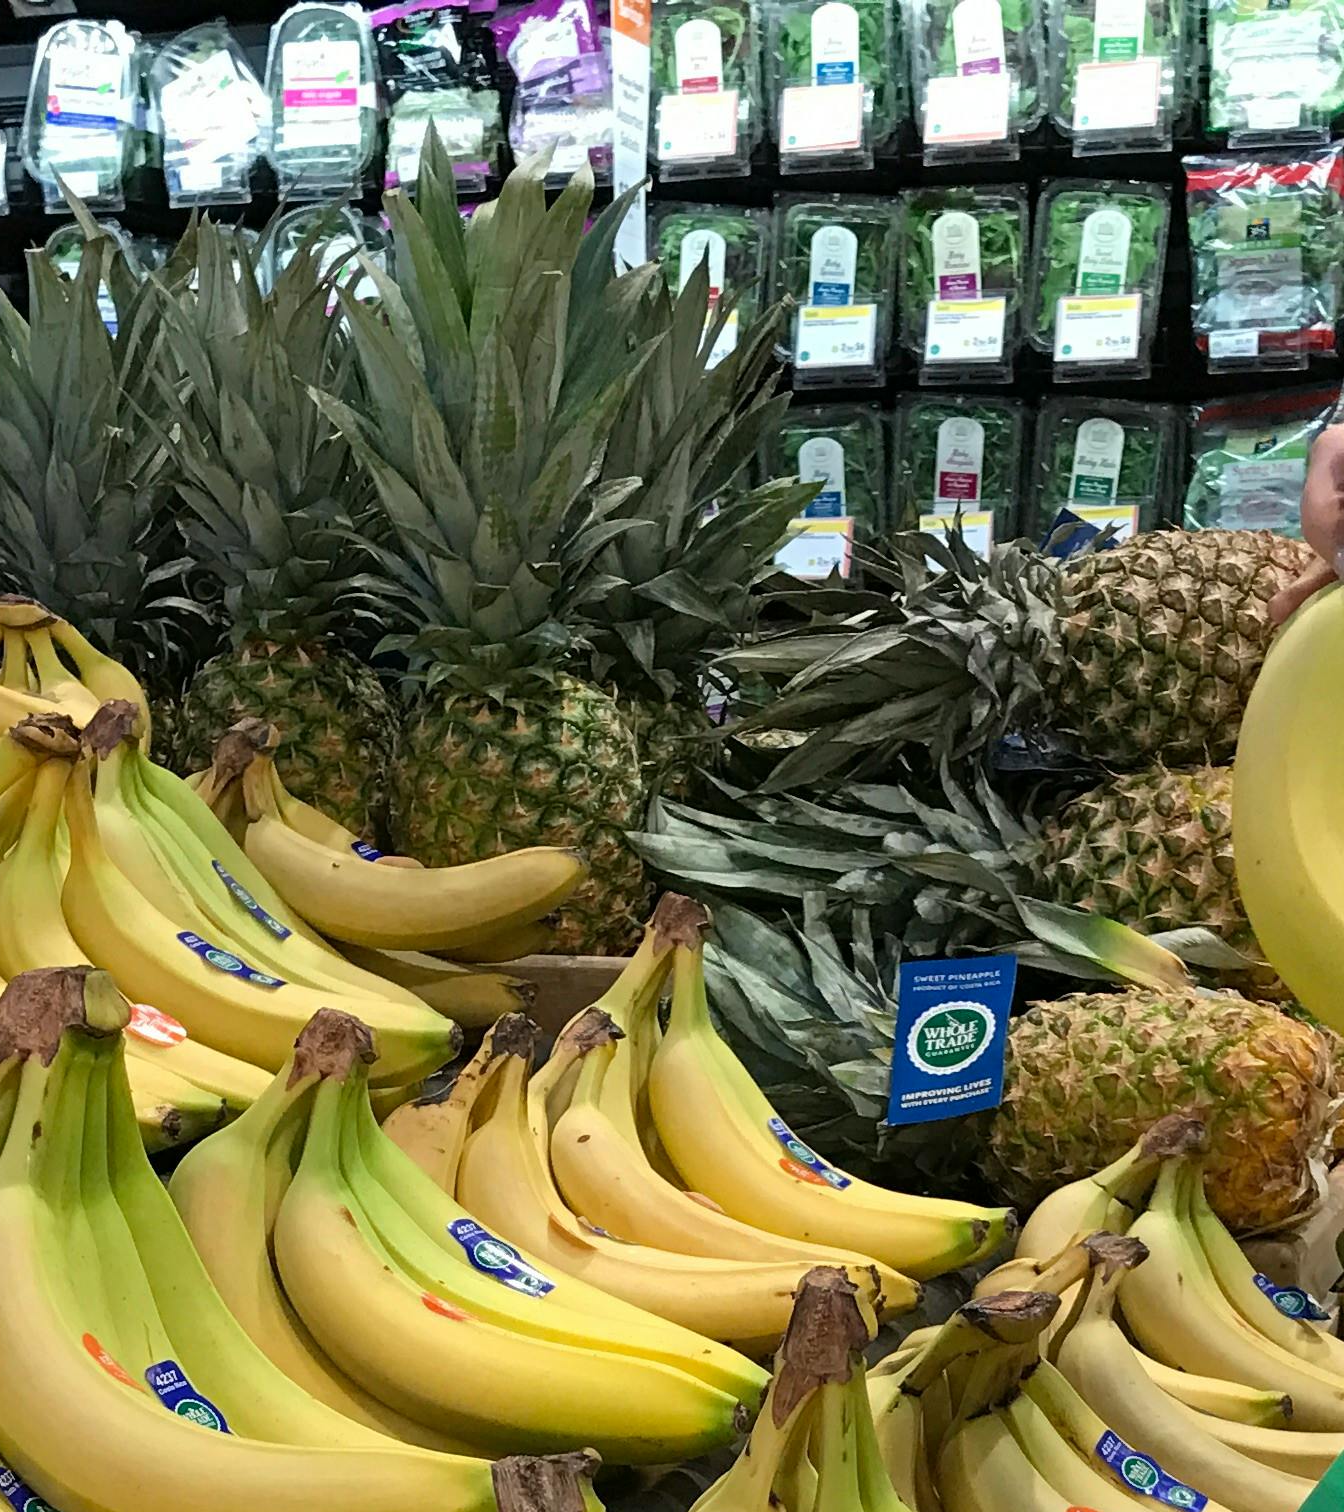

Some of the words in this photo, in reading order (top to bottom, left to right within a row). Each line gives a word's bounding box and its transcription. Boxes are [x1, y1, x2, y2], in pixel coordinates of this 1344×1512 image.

[913, 974, 945, 984] SWEET
[948, 969, 1001, 982] PINEAPPLE
[922, 1019, 979, 1040] WHOLE
[924, 1032, 977, 1051] TRADE
[900, 1084, 962, 1102] IMPROVING
[963, 1077, 993, 1092] LIVES
[154, 1369, 179, 1388] 4237
